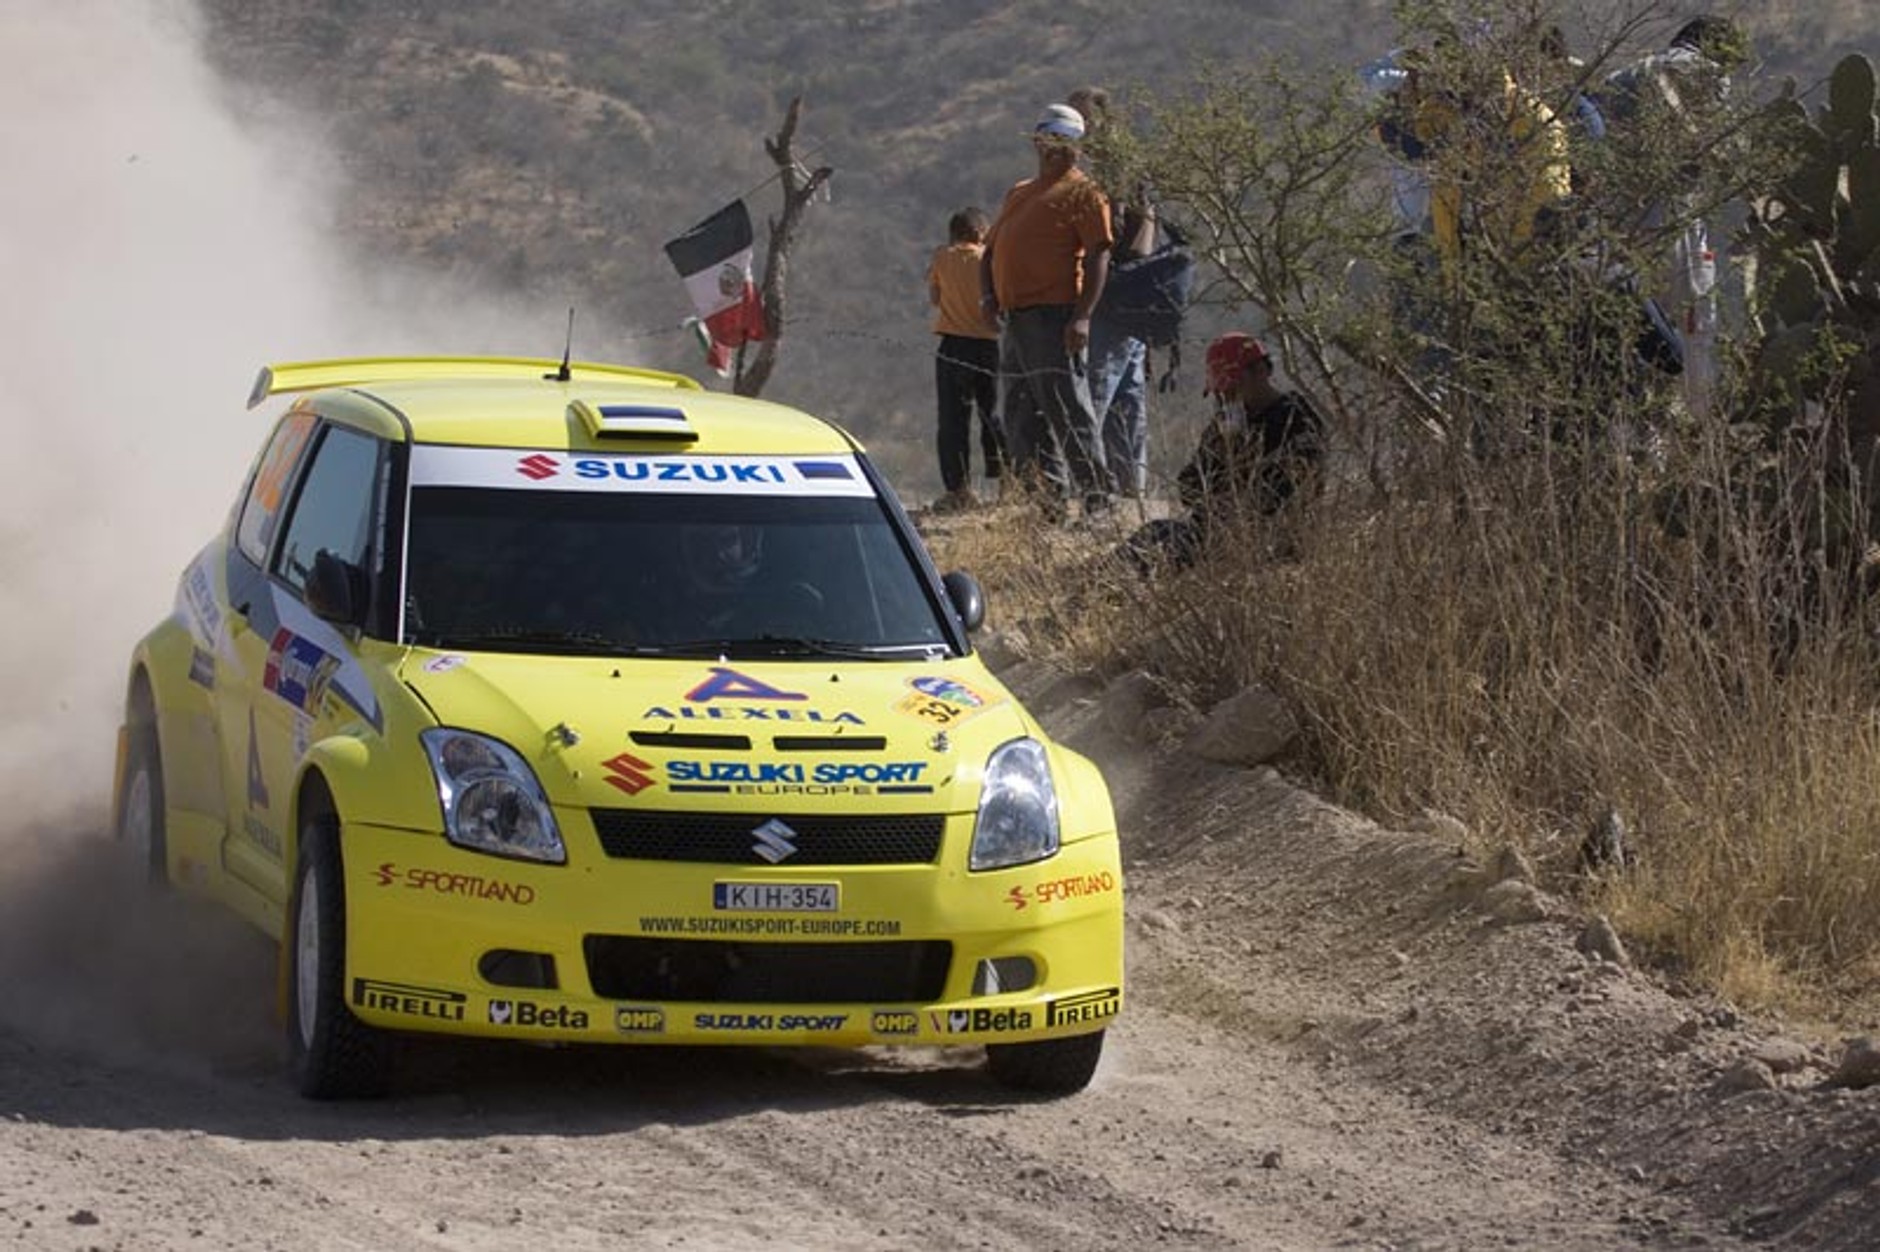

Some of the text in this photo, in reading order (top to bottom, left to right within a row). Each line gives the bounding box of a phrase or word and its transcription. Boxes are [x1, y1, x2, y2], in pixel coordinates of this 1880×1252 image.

[575, 459, 786, 483] SUZUKI
[643, 706, 866, 725] ALEXELA
[917, 701, 961, 723] 32
[666, 760, 928, 784] SUZUKI SPORT
[736, 785, 871, 796] EUROPE
[404, 868, 535, 905] SPORTLAND
[732, 887, 832, 908] KIH-354
[1036, 871, 1114, 904] SPORTLAND
[639, 917, 901, 936] WWW.SUZUKISPORT-EUROPE.COM
[353, 977, 467, 1021] PIRELLI
[1046, 987, 1120, 1028] PIRELLI
[515, 1003, 589, 1029] Beta
[618, 1009, 662, 1032] OMP
[694, 1014, 848, 1031] SUZUKI SPORT
[872, 1012, 918, 1035] OMP
[973, 1009, 1031, 1032] Beta
